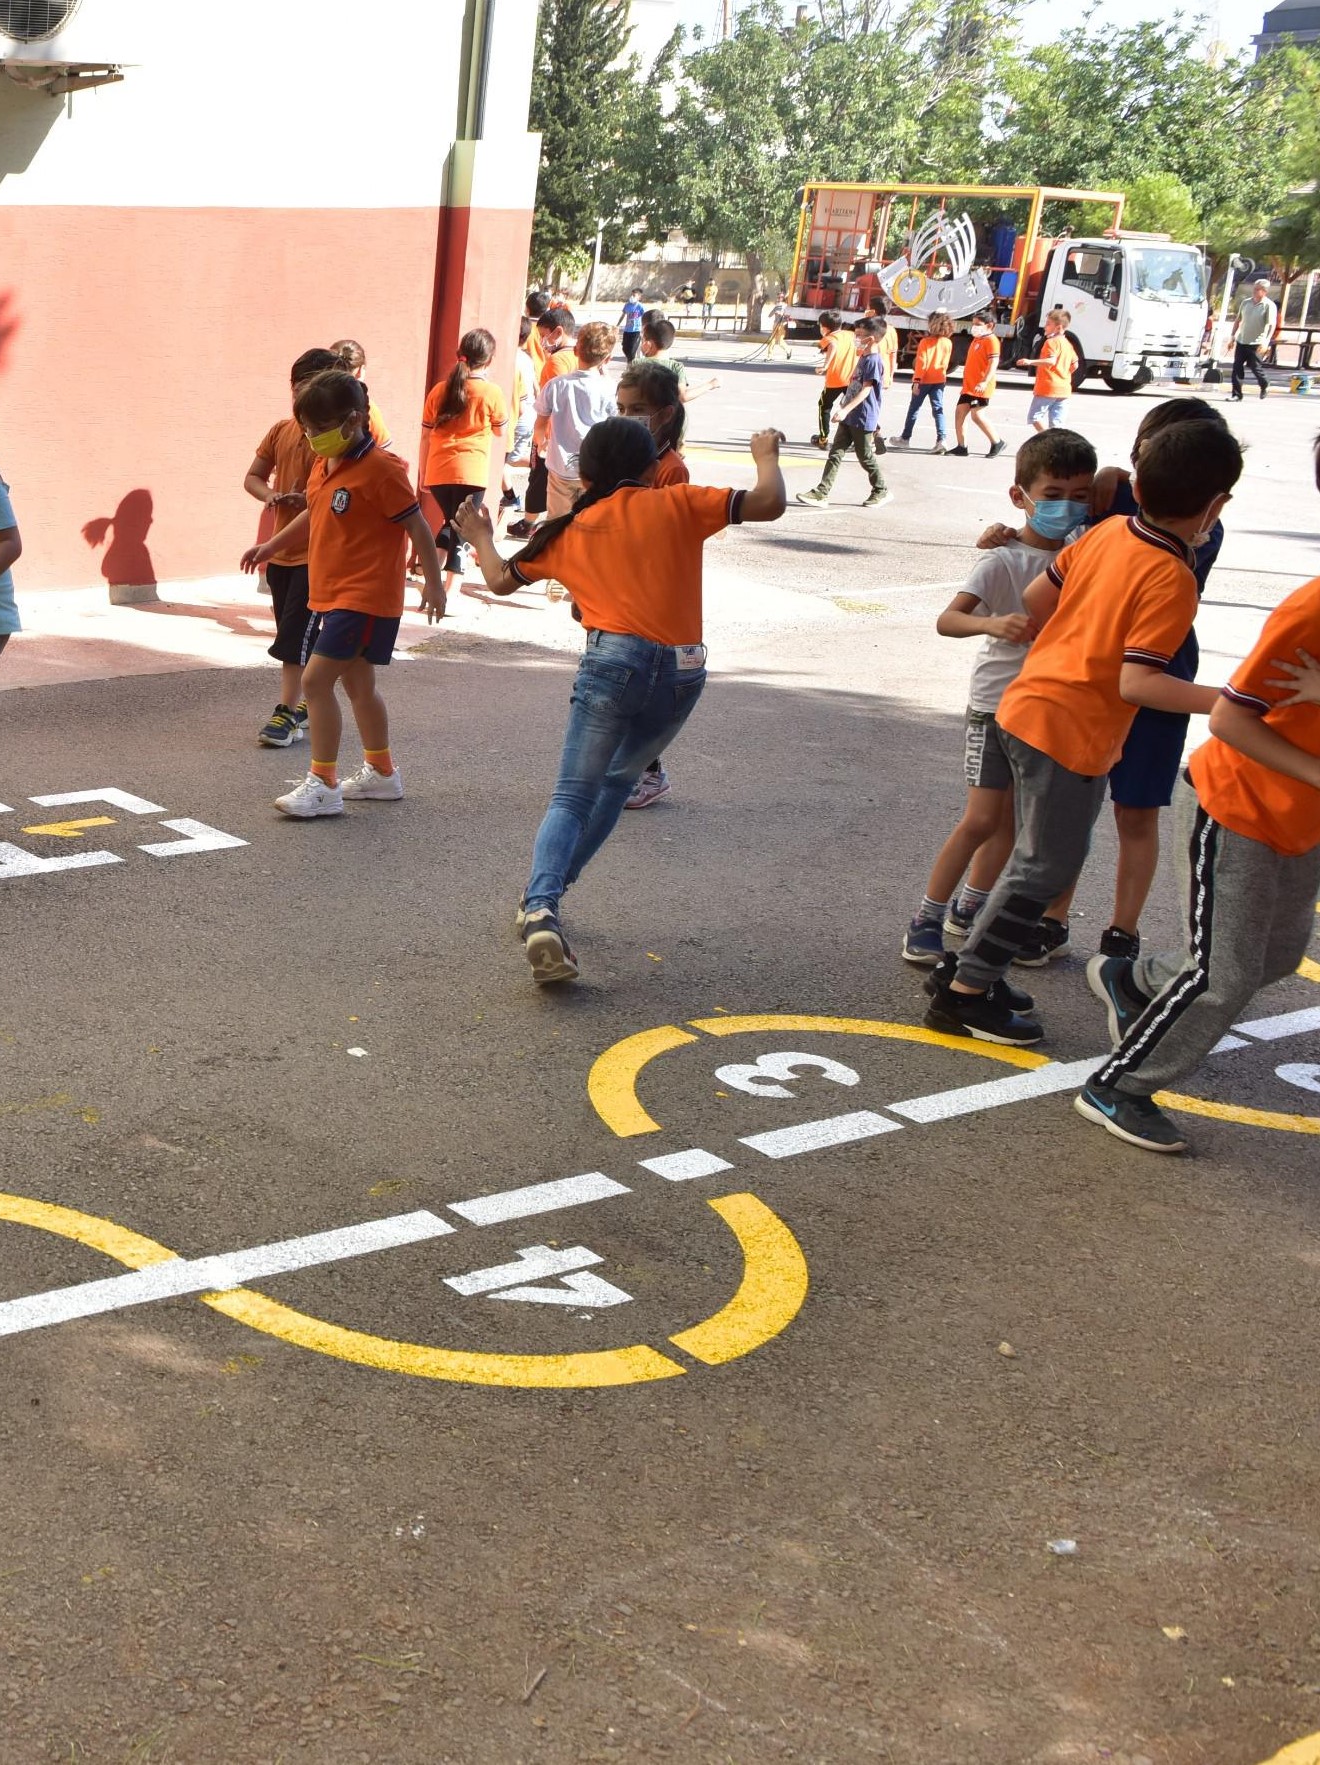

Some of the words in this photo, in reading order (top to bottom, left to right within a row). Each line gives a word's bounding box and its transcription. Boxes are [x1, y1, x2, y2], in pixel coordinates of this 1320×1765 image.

[22, 815, 118, 838] 1
[714, 1051, 861, 1099] 3
[443, 1245, 633, 1308] 4
